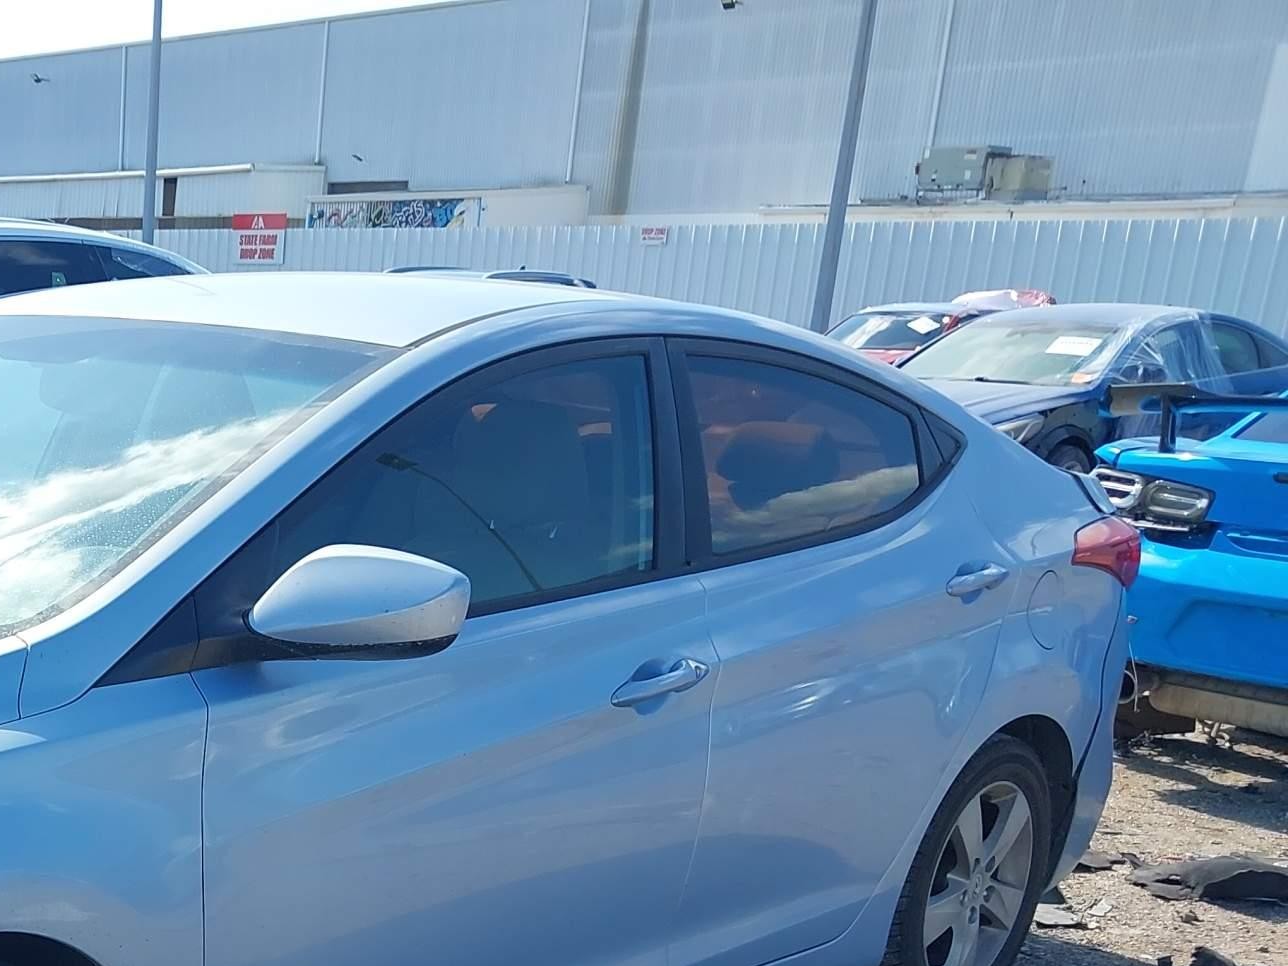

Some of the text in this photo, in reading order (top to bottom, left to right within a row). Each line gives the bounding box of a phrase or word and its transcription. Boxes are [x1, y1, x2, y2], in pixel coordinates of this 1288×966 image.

[239, 234, 278, 246] STATE FARM
[239, 248, 275, 260] DROP ZONE
